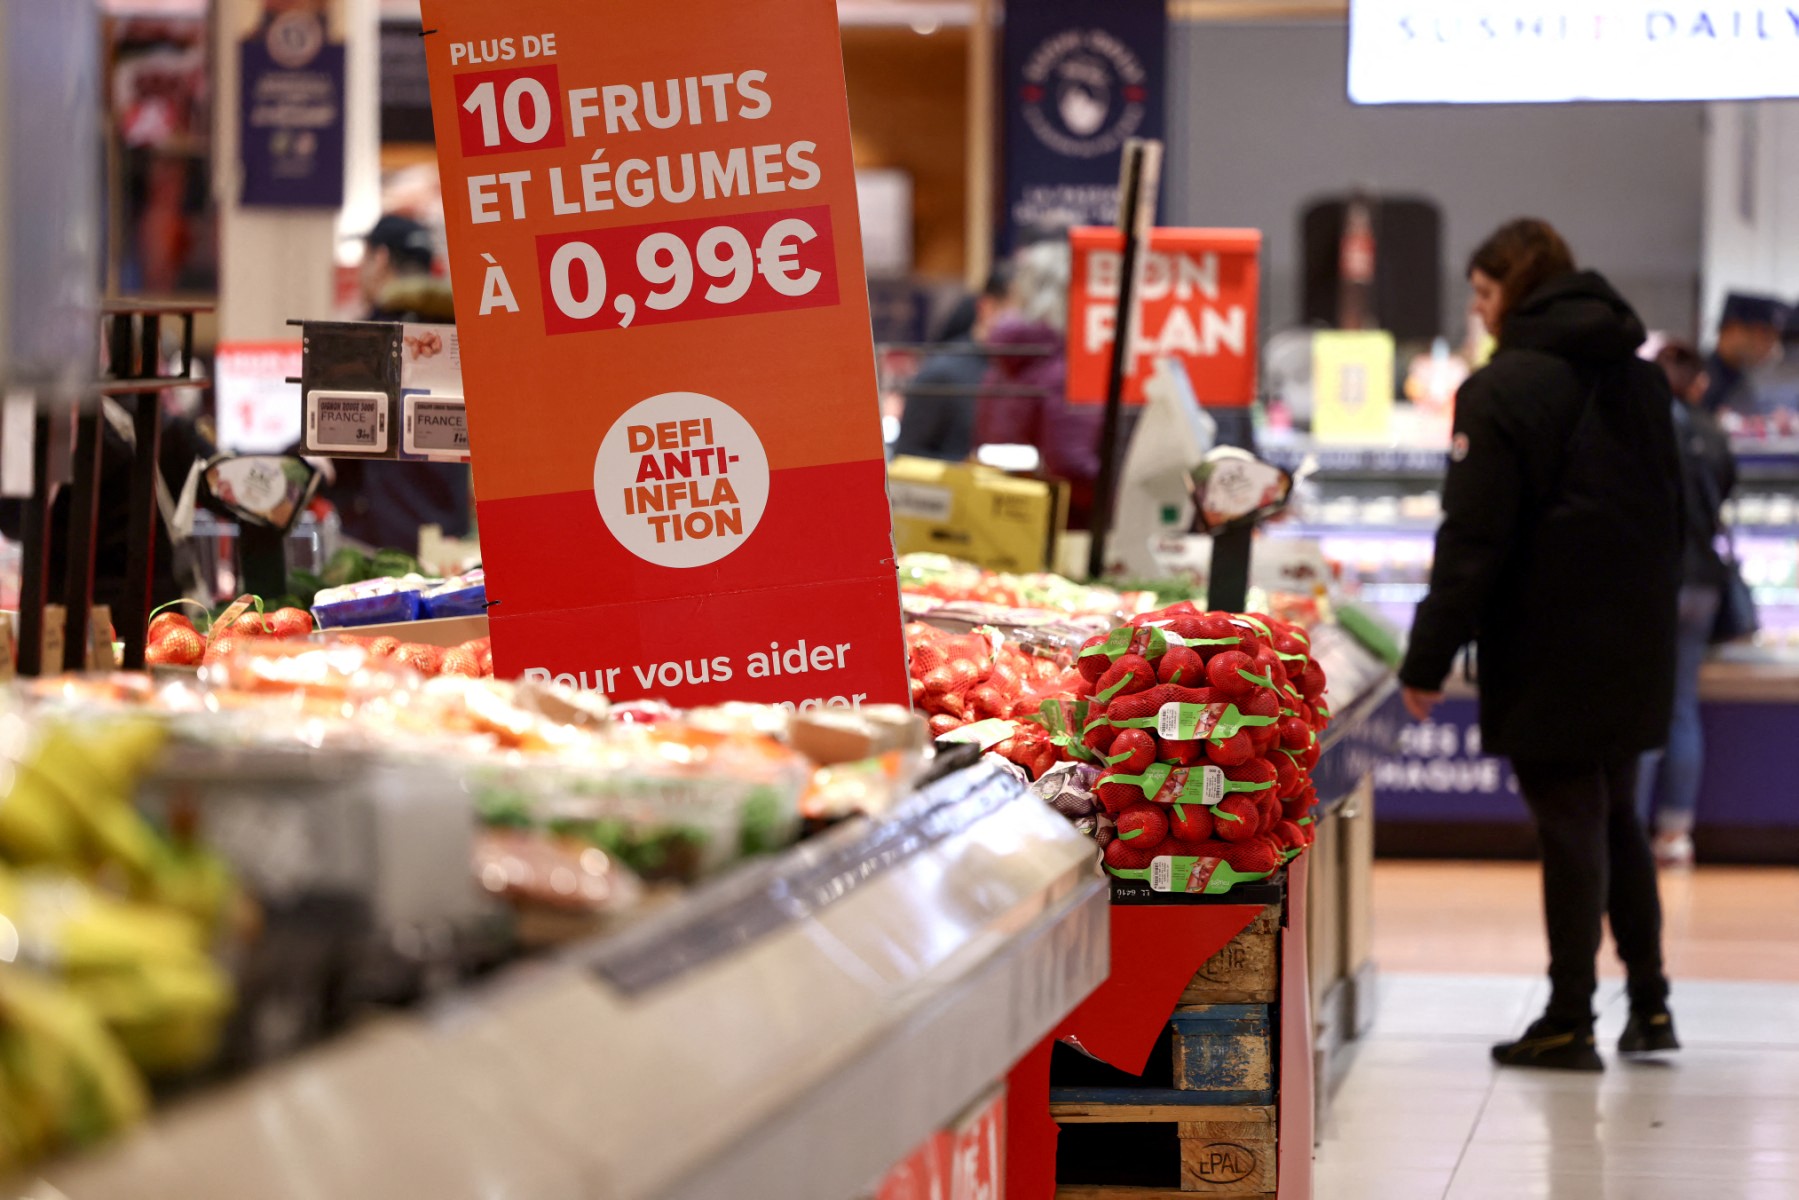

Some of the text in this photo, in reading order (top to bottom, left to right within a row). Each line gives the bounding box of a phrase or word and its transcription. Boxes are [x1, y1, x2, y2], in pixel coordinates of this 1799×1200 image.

[1398, 15, 1567, 42] SUSHI
[450, 34, 556, 65] PLUS DE
[463, 70, 771, 146] 10 FRUITS
[468, 141, 820, 223] ET LÉGUMES
[480, 219, 821, 328] À 0,99€
[1085, 304, 1246, 356] PLAN
[320, 411, 366, 423] FRANCE
[417, 415, 463, 427] FRANCE
[627, 418, 713, 453] DEFI
[636, 447, 739, 483] ANTI-
[624, 478, 738, 515] INFLA
[648, 508, 742, 543] TION
[633, 657, 732, 689] vous
[747, 639, 850, 677] aider
